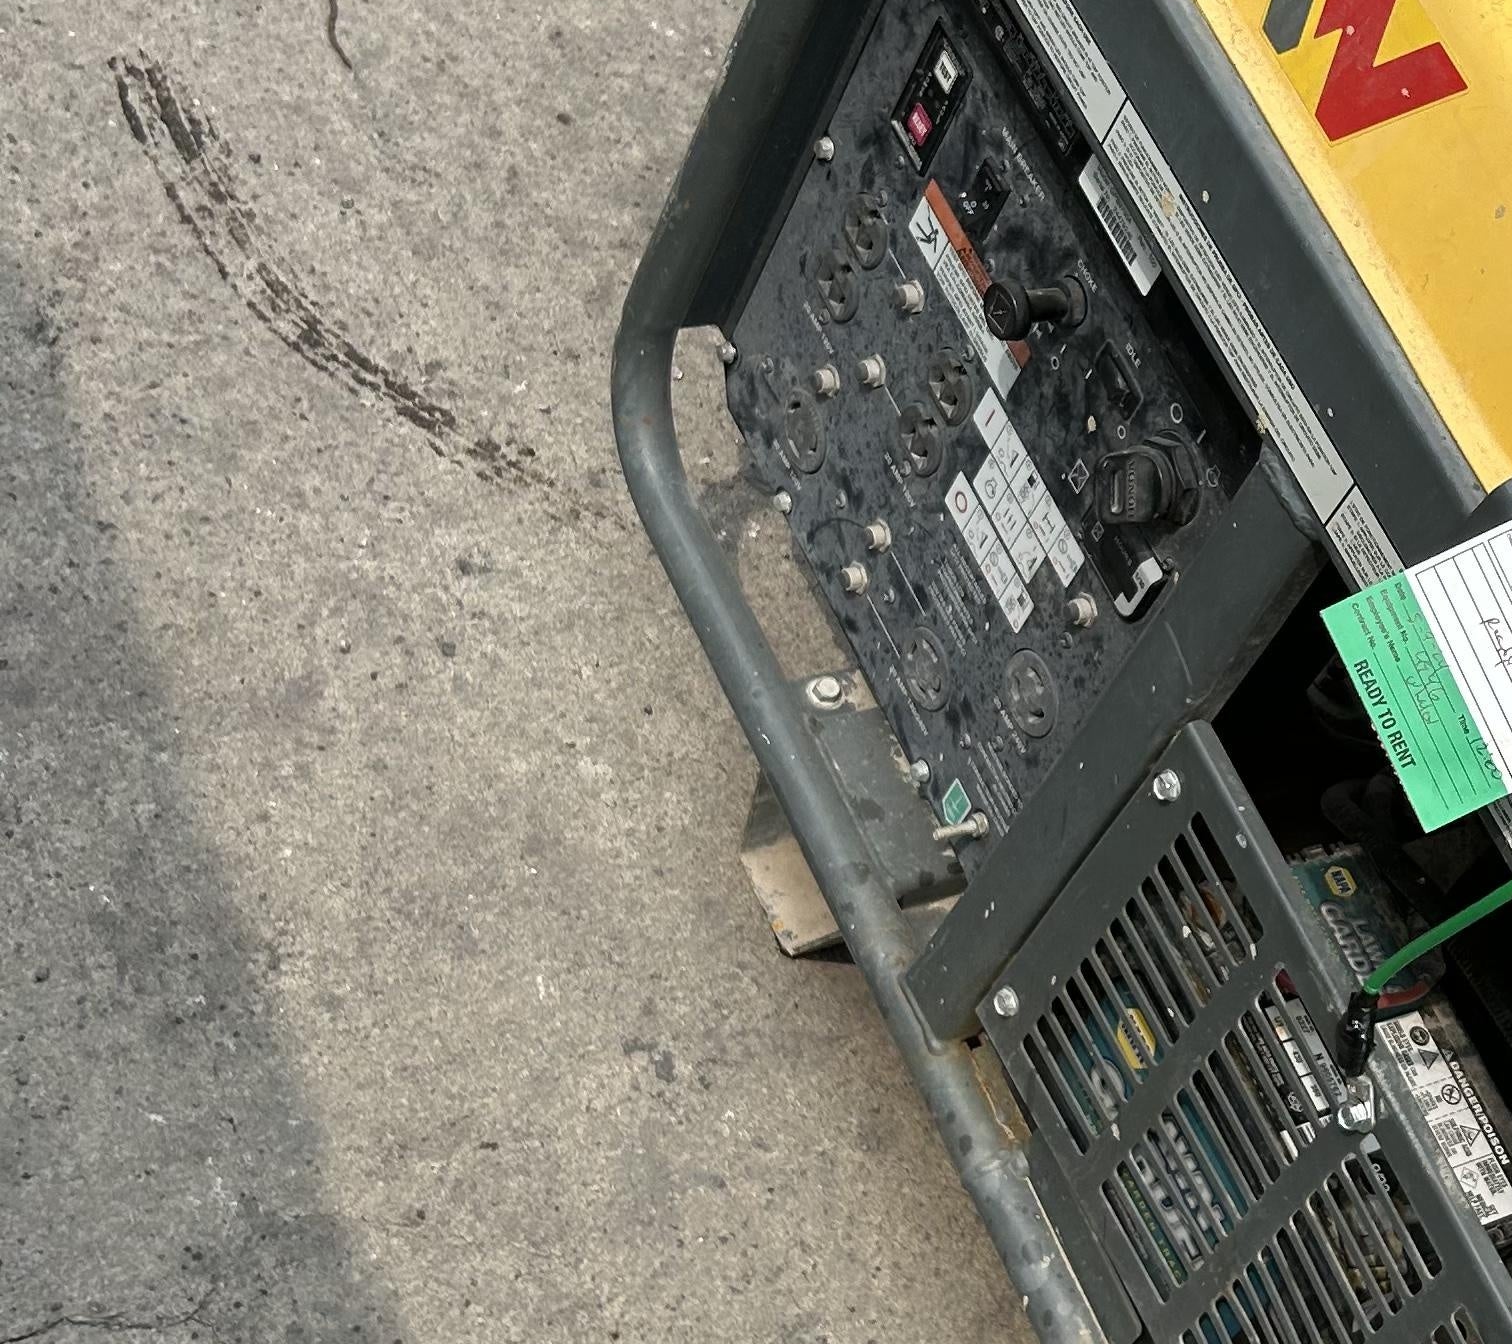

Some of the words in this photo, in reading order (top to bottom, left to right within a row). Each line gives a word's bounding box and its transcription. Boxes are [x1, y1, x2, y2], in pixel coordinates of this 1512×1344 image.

[1014, 152, 1046, 202] BREAKER
[1075, 258, 1099, 294] CHOKE
[1123, 342, 1142, 368] IDLE
[1349, 601, 1372, 636] Contract
[1352, 658, 1387, 710] READY
[1375, 707, 1397, 731] TO
[1386, 729, 1417, 771] RENT
[1330, 869, 1352, 896] NAPA
[1448, 1059, 1509, 1166] DANGER/POISON
